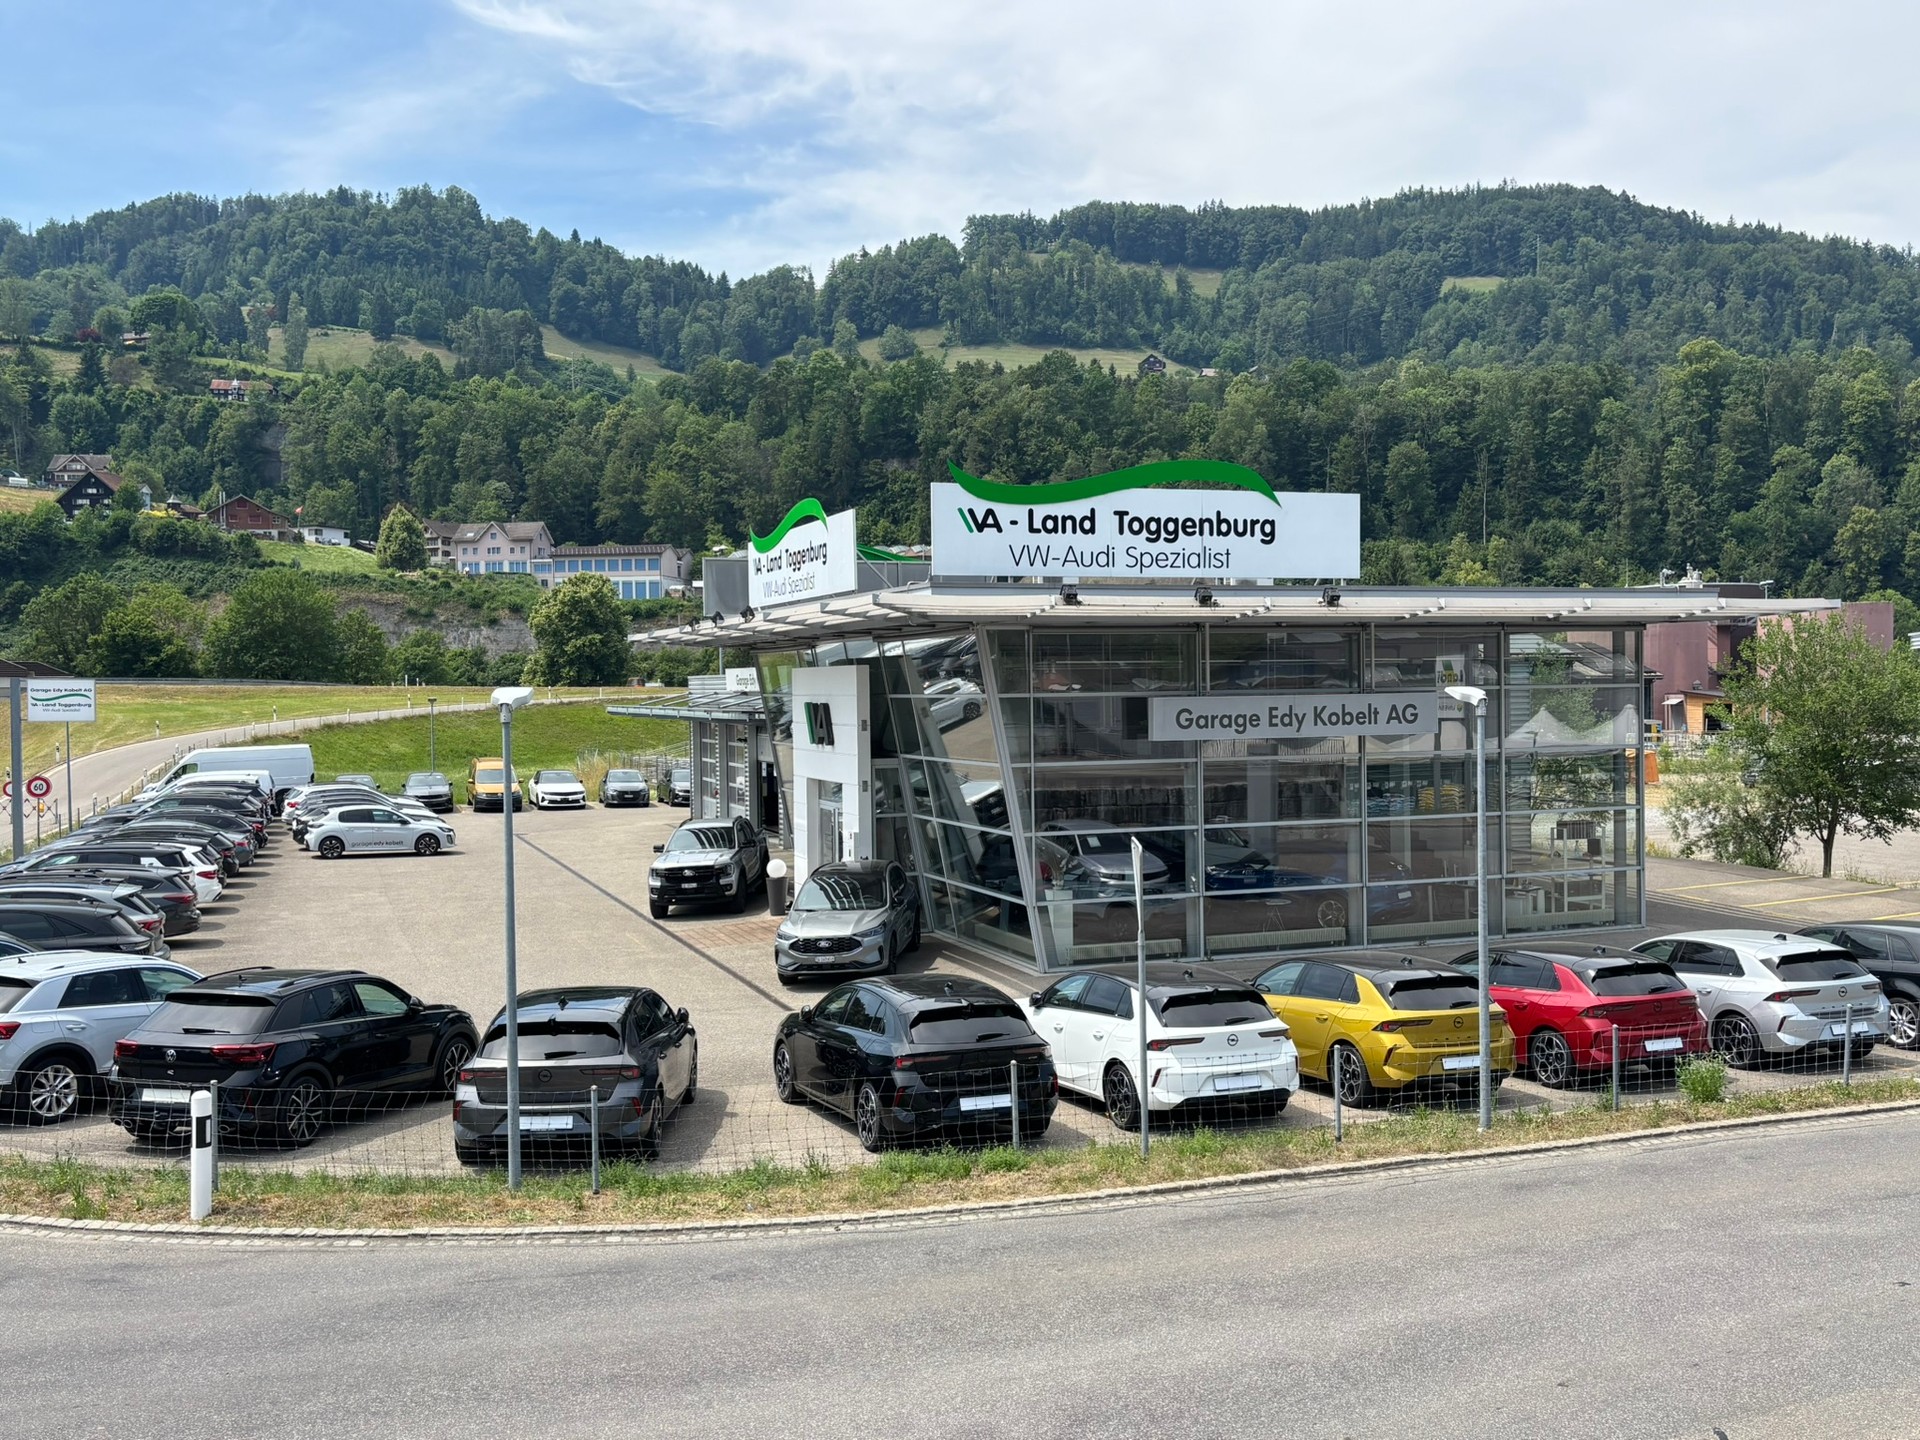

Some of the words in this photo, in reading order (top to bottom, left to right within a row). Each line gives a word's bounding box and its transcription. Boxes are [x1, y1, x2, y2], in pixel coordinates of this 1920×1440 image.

[1028, 507, 1096, 535] Land
[1113, 510, 1276, 545] Toggenburg
[766, 549, 782, 573] Land
[785, 540, 827, 573] Toggenburg
[1008, 544, 1116, 568] VW-Audi
[1125, 546, 1231, 574] Spezialist
[762, 577, 787, 599] VW-Audi
[788, 571, 816, 598] Spezialist
[1175, 709, 1261, 734] Garage
[1268, 705, 1306, 733] Edy
[1313, 703, 1380, 727] Kobelt
[1386, 704, 1419, 725] AG
[33, 783, 44, 791] 60
